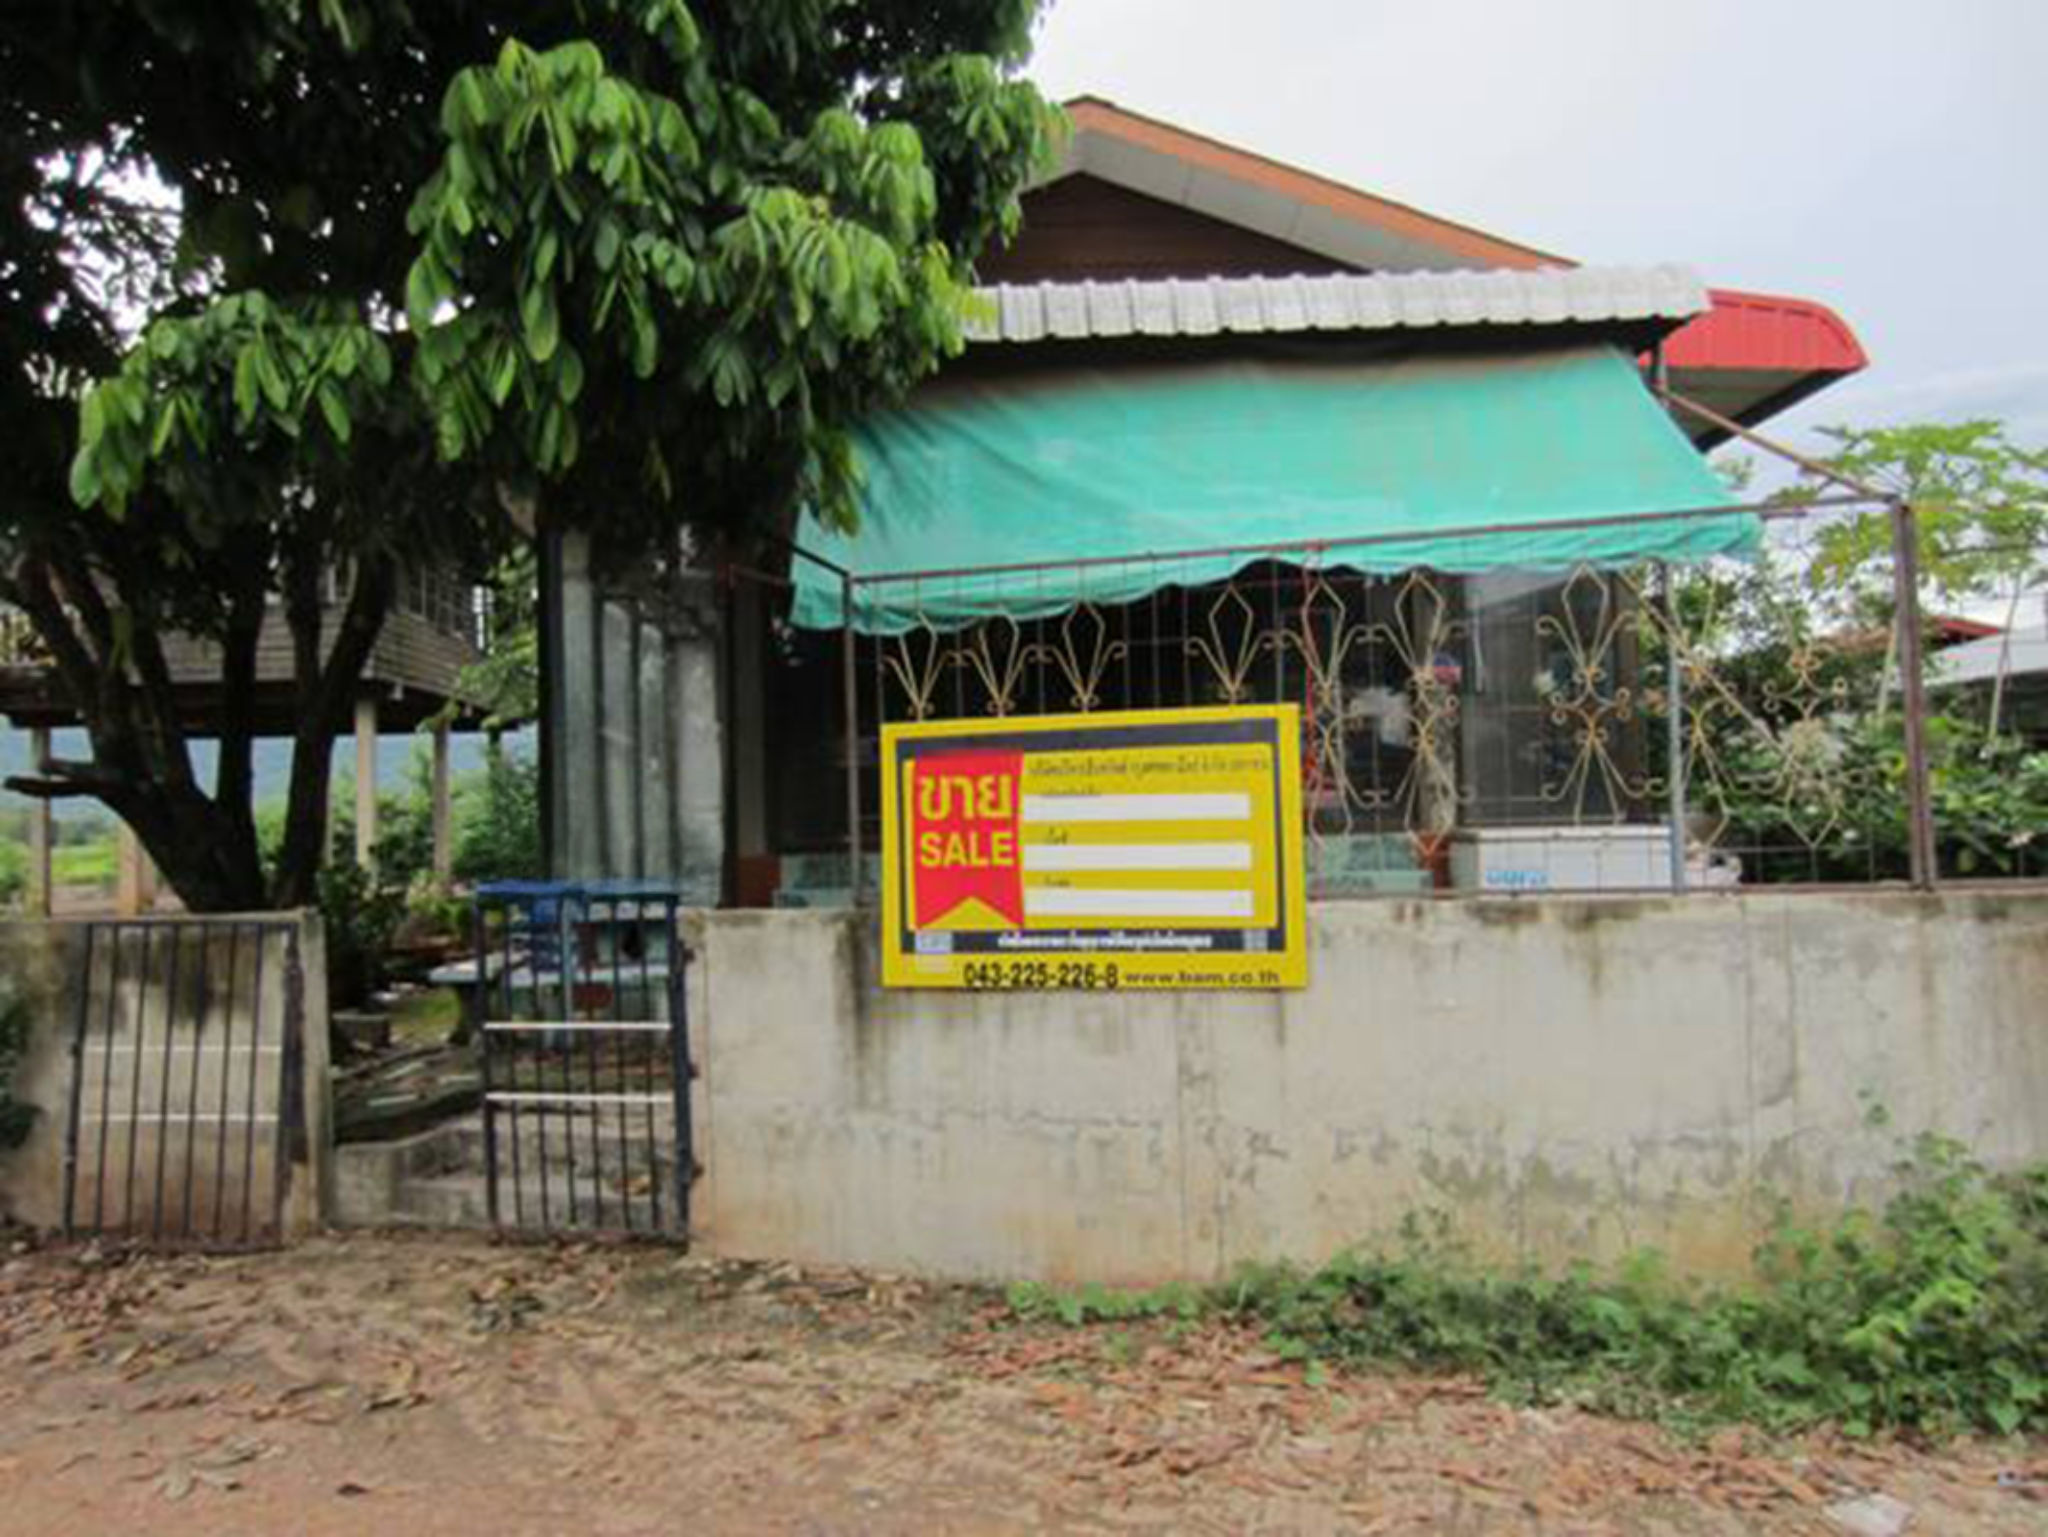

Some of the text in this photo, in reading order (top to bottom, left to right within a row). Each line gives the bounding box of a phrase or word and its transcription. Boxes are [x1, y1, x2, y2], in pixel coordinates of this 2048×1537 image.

[920, 774, 1012, 820] ขาย
[920, 831, 1014, 866] SALE
[963, 962, 1119, 988] 043-225-226-8
